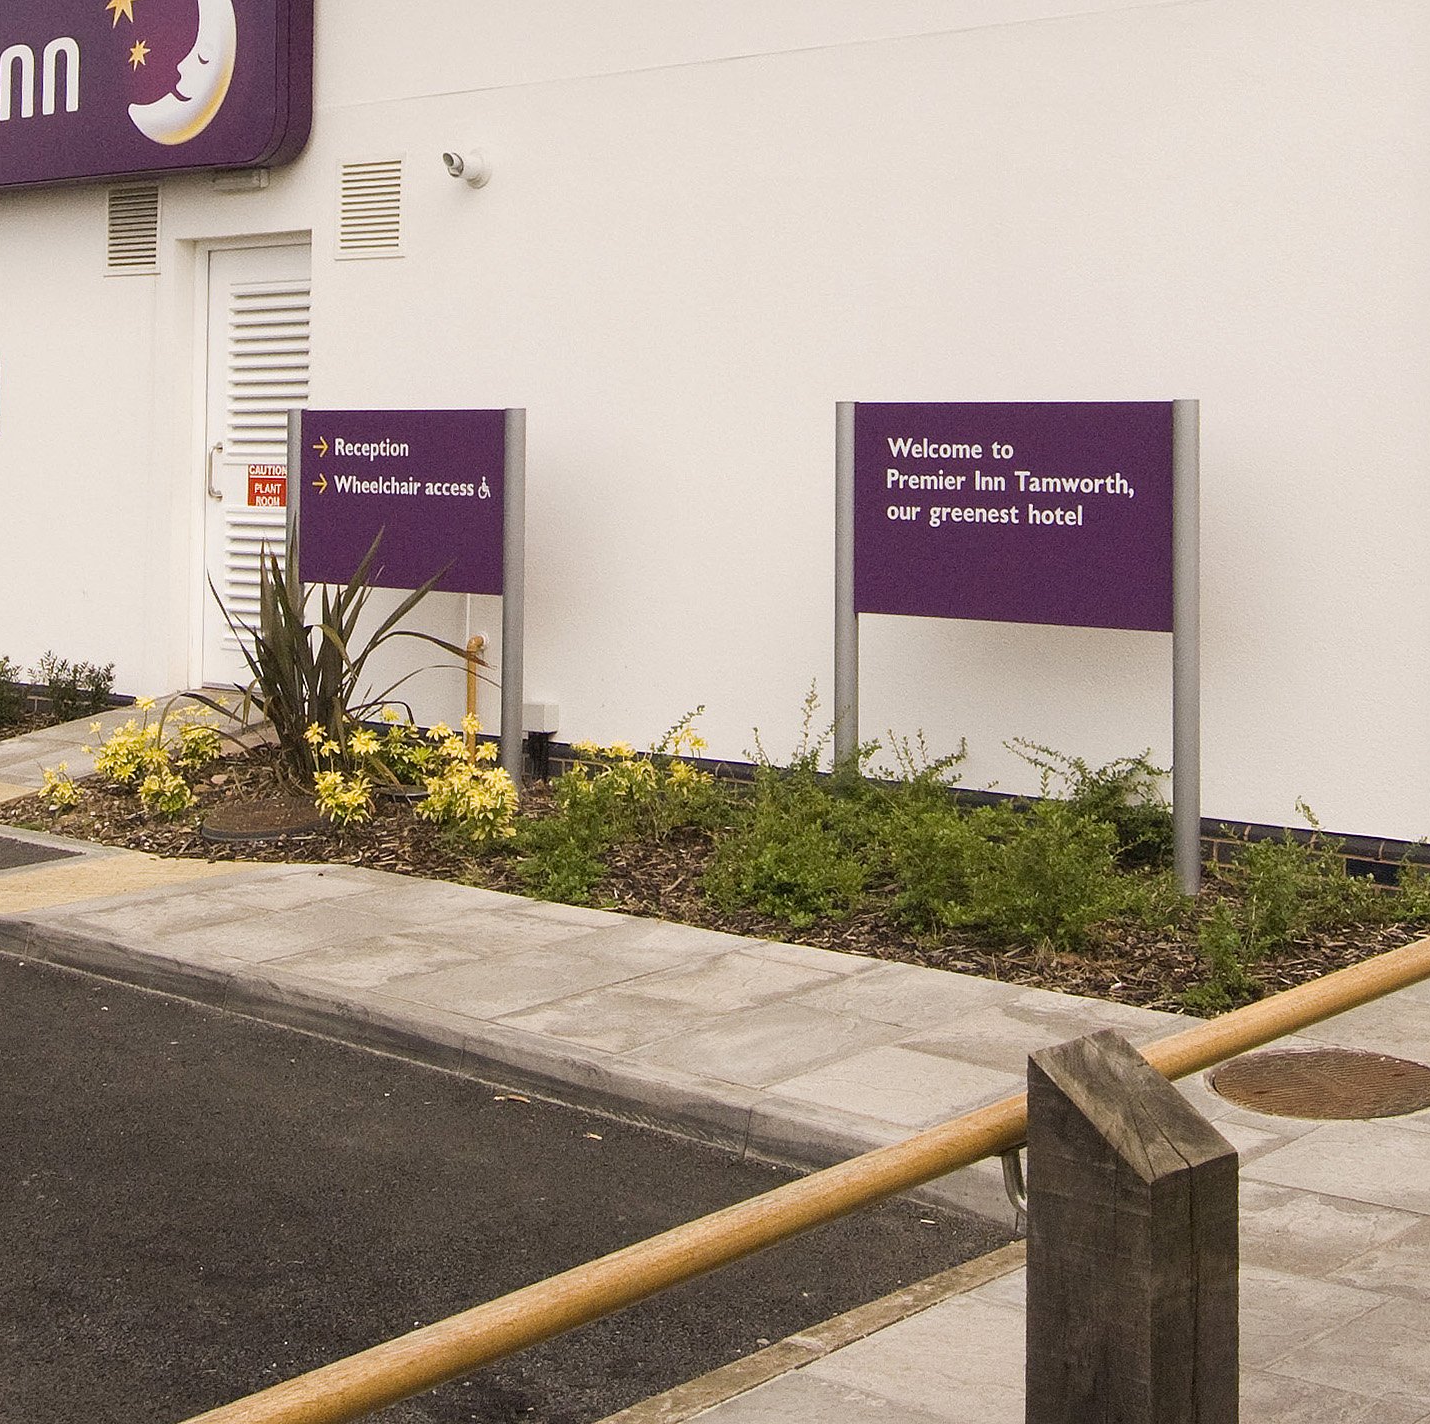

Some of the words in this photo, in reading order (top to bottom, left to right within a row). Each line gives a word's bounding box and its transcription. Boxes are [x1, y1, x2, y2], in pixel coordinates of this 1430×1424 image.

[334, 437, 409, 462] Reception
[887, 437, 983, 459] Welcome
[991, 441, 1014, 459] to
[249, 465, 287, 476] CAUTION
[254, 482, 282, 495] PLANT
[334, 474, 421, 496] Wheelchair
[424, 481, 474, 497] access
[886, 468, 966, 490] Premier
[974, 470, 1006, 492] Inn
[1014, 470, 1135, 498] Tamworth,
[255, 495, 281, 506] ROOM
[886, 505, 921, 521] our
[929, 505, 1019, 527] greenest
[1027, 503, 1084, 526] hotel
